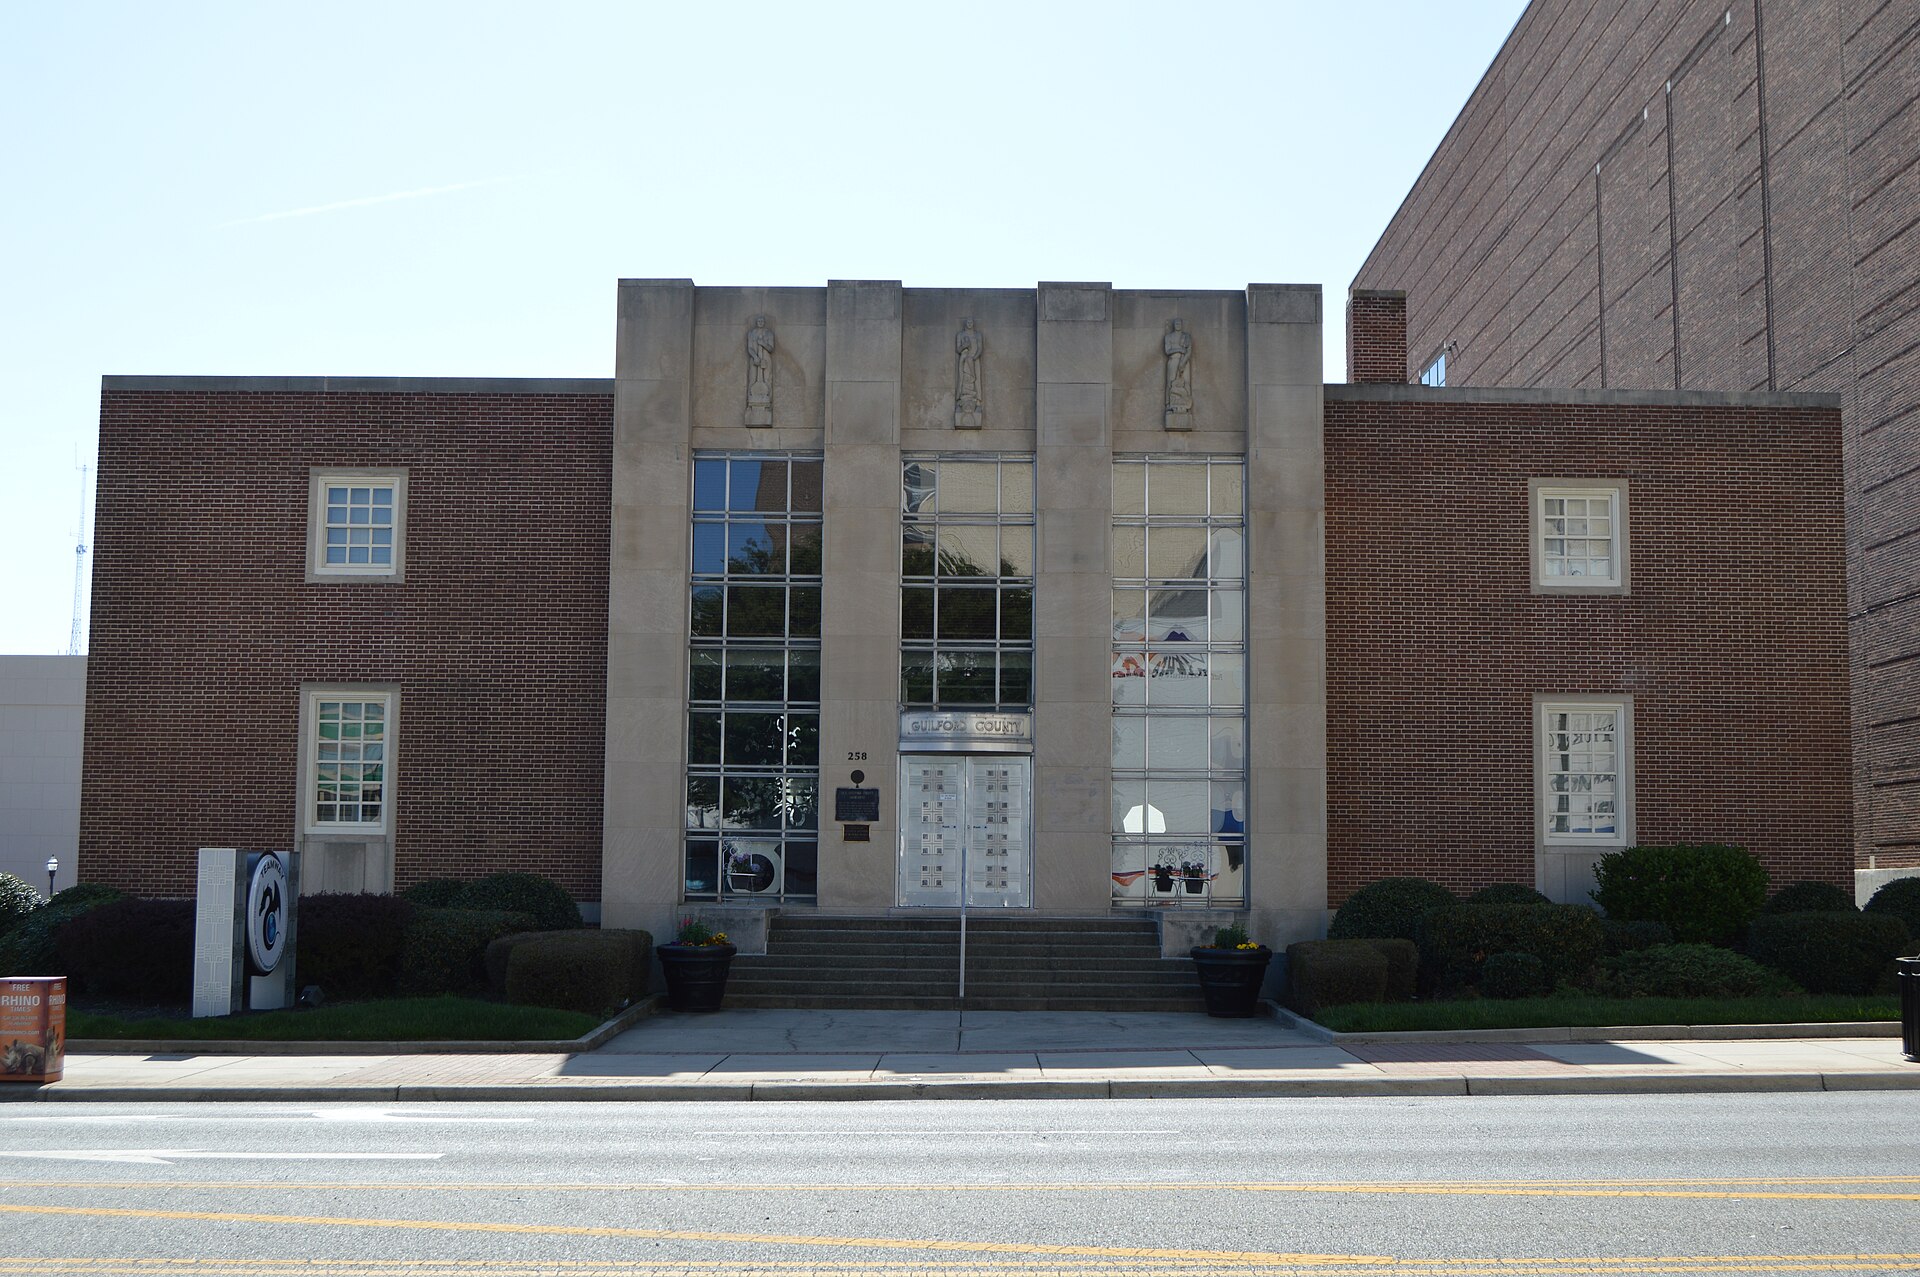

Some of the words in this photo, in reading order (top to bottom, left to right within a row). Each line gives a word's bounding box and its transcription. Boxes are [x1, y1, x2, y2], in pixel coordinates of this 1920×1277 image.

[911, 720, 967, 732] GUILFORD
[975, 720, 1021, 733] COUNTY
[847, 752, 868, 761] 258
[12, 983, 30, 991] FREE
[1, 995, 40, 1006] RHINO
